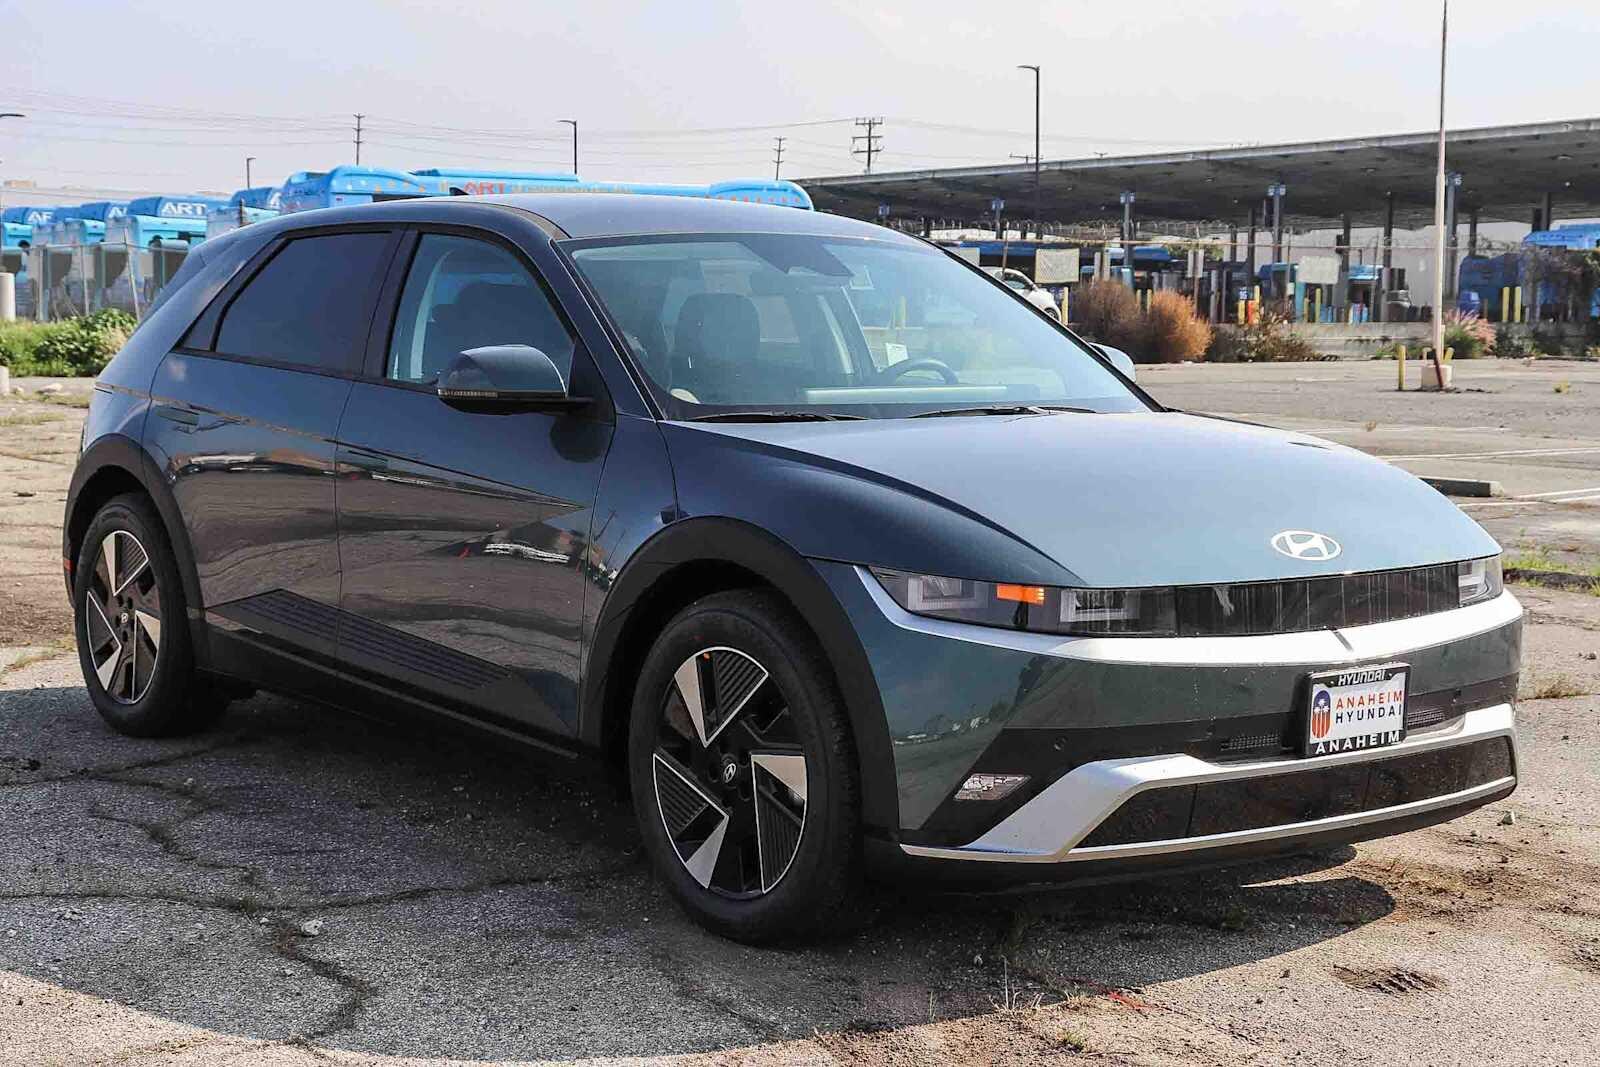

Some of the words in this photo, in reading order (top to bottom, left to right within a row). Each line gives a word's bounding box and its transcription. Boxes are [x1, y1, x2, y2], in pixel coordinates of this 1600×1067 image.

[463, 181, 506, 195] ART
[162, 202, 207, 216] ART
[1338, 669, 1386, 686] HYUNDAI
[1336, 690, 1403, 711] ANAHEIM
[1335, 704, 1402, 724] HYUNDAI
[1315, 731, 1400, 754] ANAHEIM
